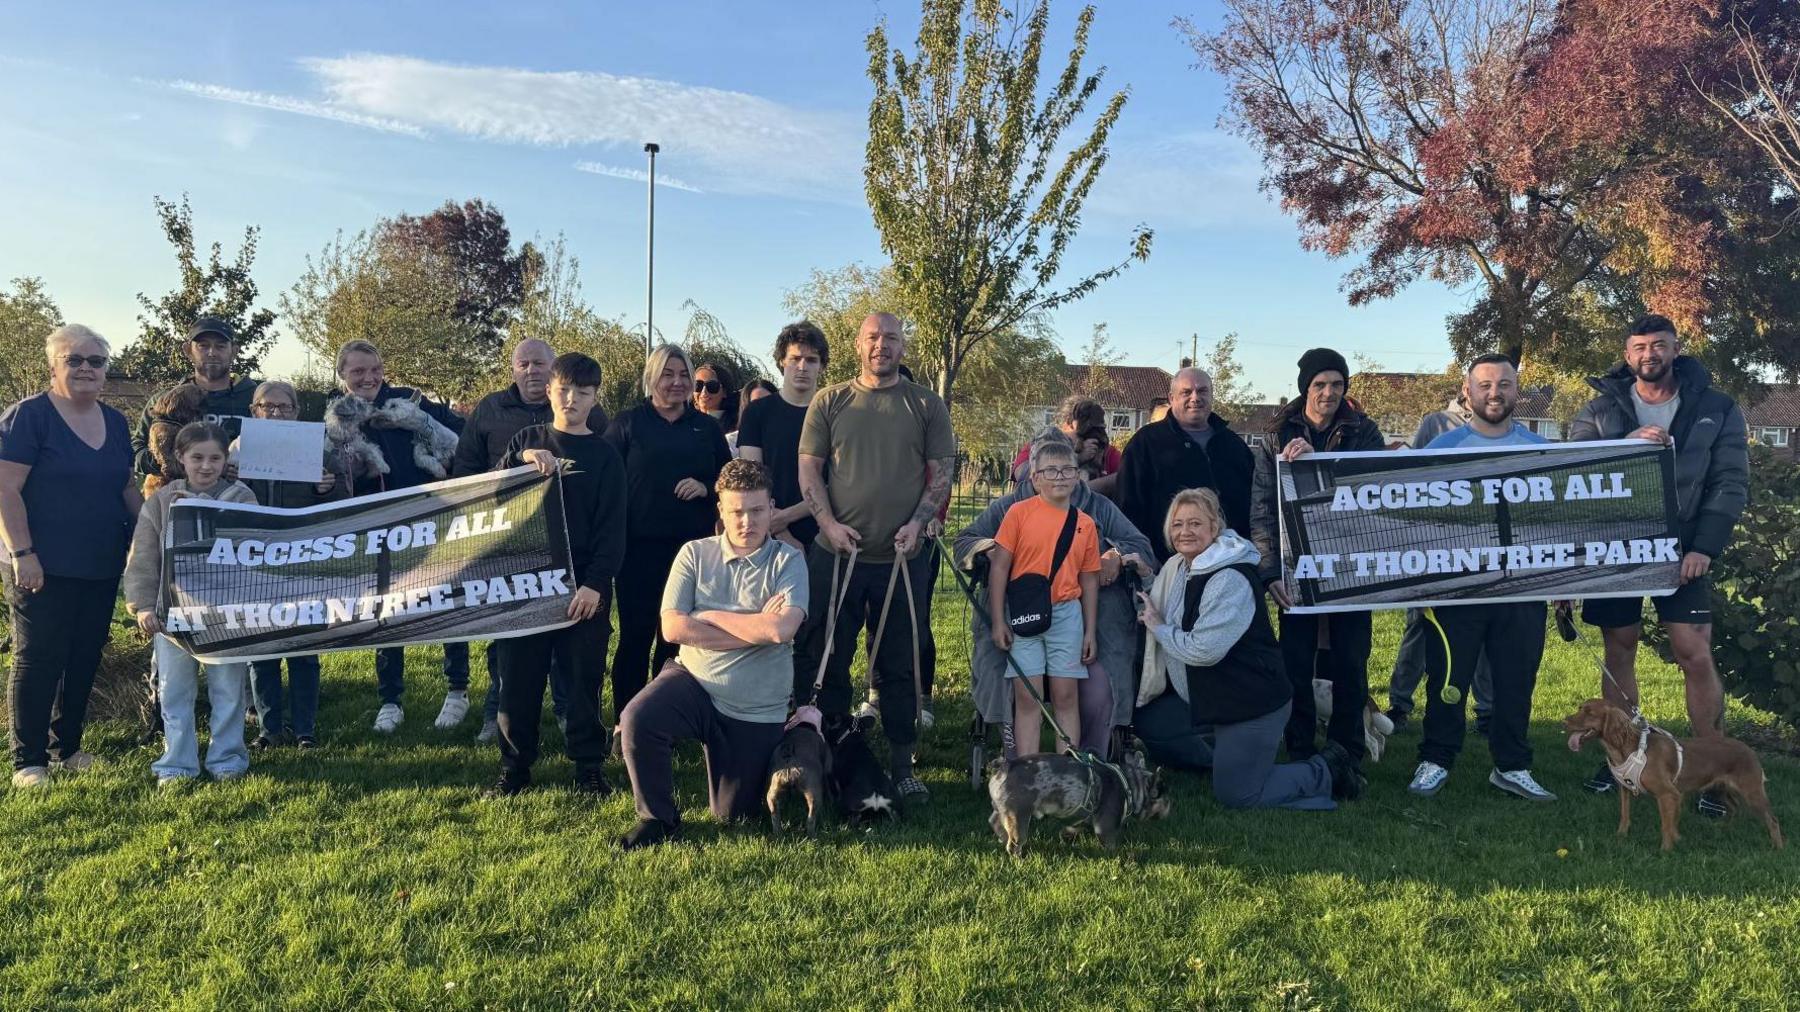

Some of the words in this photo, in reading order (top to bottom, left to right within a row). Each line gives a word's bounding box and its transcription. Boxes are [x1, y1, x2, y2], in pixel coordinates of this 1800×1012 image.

[1330, 480, 1473, 511] ACCESS
[1481, 476, 1555, 505] FOR
[1564, 472, 1632, 500] ALL
[207, 534, 356, 567] ACCESS
[366, 521, 437, 555] FOR
[445, 508, 511, 542] ALL
[1294, 554, 1339, 579] AT
[1349, 543, 1575, 577] THORNTREE
[1584, 538, 1679, 566] PARK
[166, 606, 207, 632] AT
[217, 584, 455, 630] THORNTREE
[462, 569, 570, 606] PARK
[1011, 613, 1041, 626] adidas
